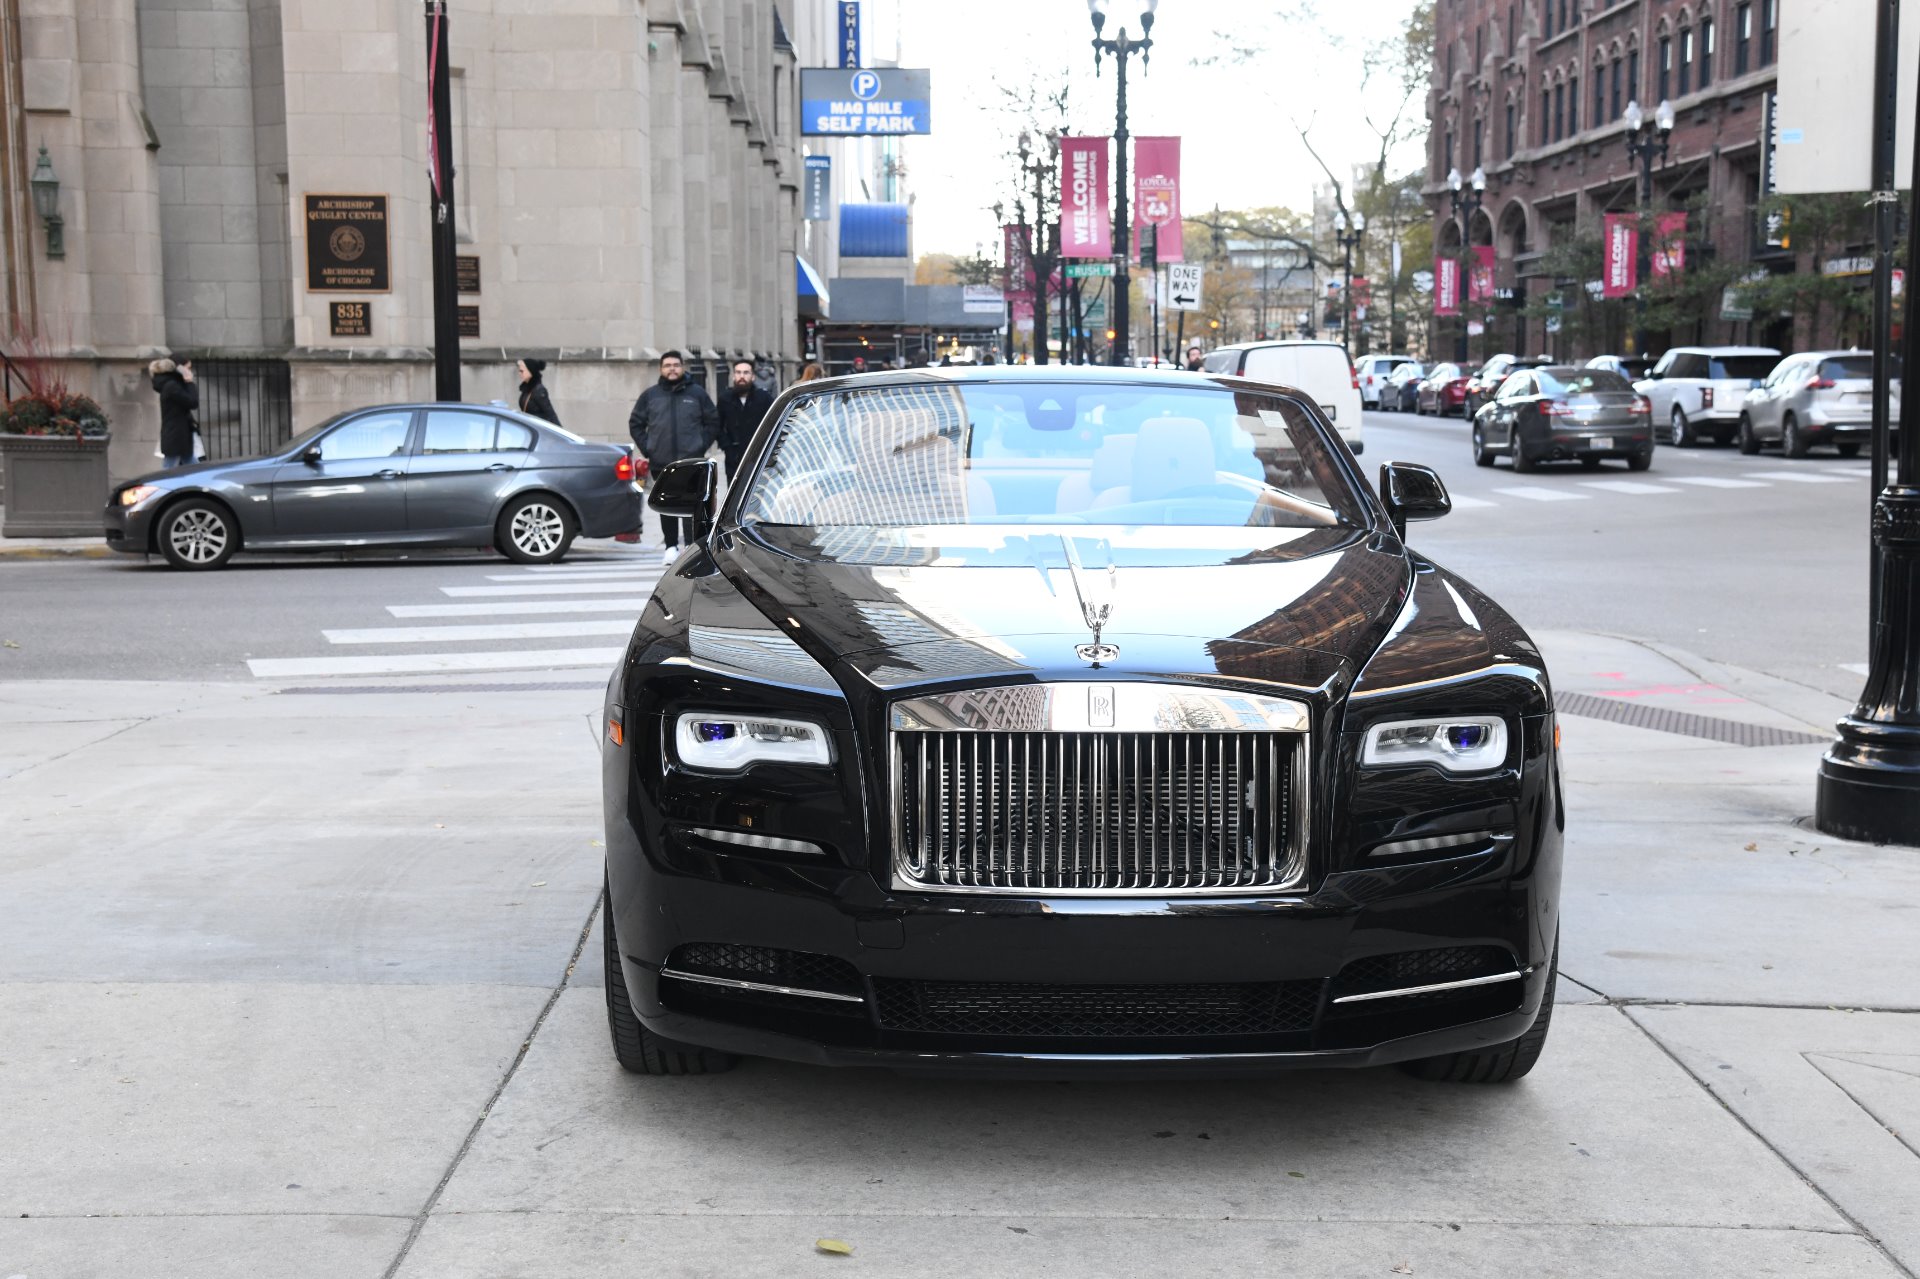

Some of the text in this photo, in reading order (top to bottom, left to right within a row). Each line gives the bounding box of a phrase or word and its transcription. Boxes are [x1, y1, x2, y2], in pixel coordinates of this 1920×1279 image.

[858, 74, 875, 96] P
[830, 102, 903, 115] MAG MILE
[817, 116, 915, 132] SELF PARK
[805, 160, 829, 168] HOTEL
[1088, 150, 1098, 186] CAMPUS
[1139, 177, 1176, 187] LOYOLA
[1073, 150, 1089, 246] WELCOME
[317, 200, 375, 210] ARCHBISHOP
[308, 211, 384, 221] QUIGLEY CENTER
[321, 268, 376, 276] ARCHDIOCESE
[1075, 265, 1100, 276] RUSH
[1173, 267, 1198, 280] ONE
[325, 277, 372, 285] OF CHICAGO
[1172, 281, 1198, 292] WAY
[337, 303, 364, 319] 835
